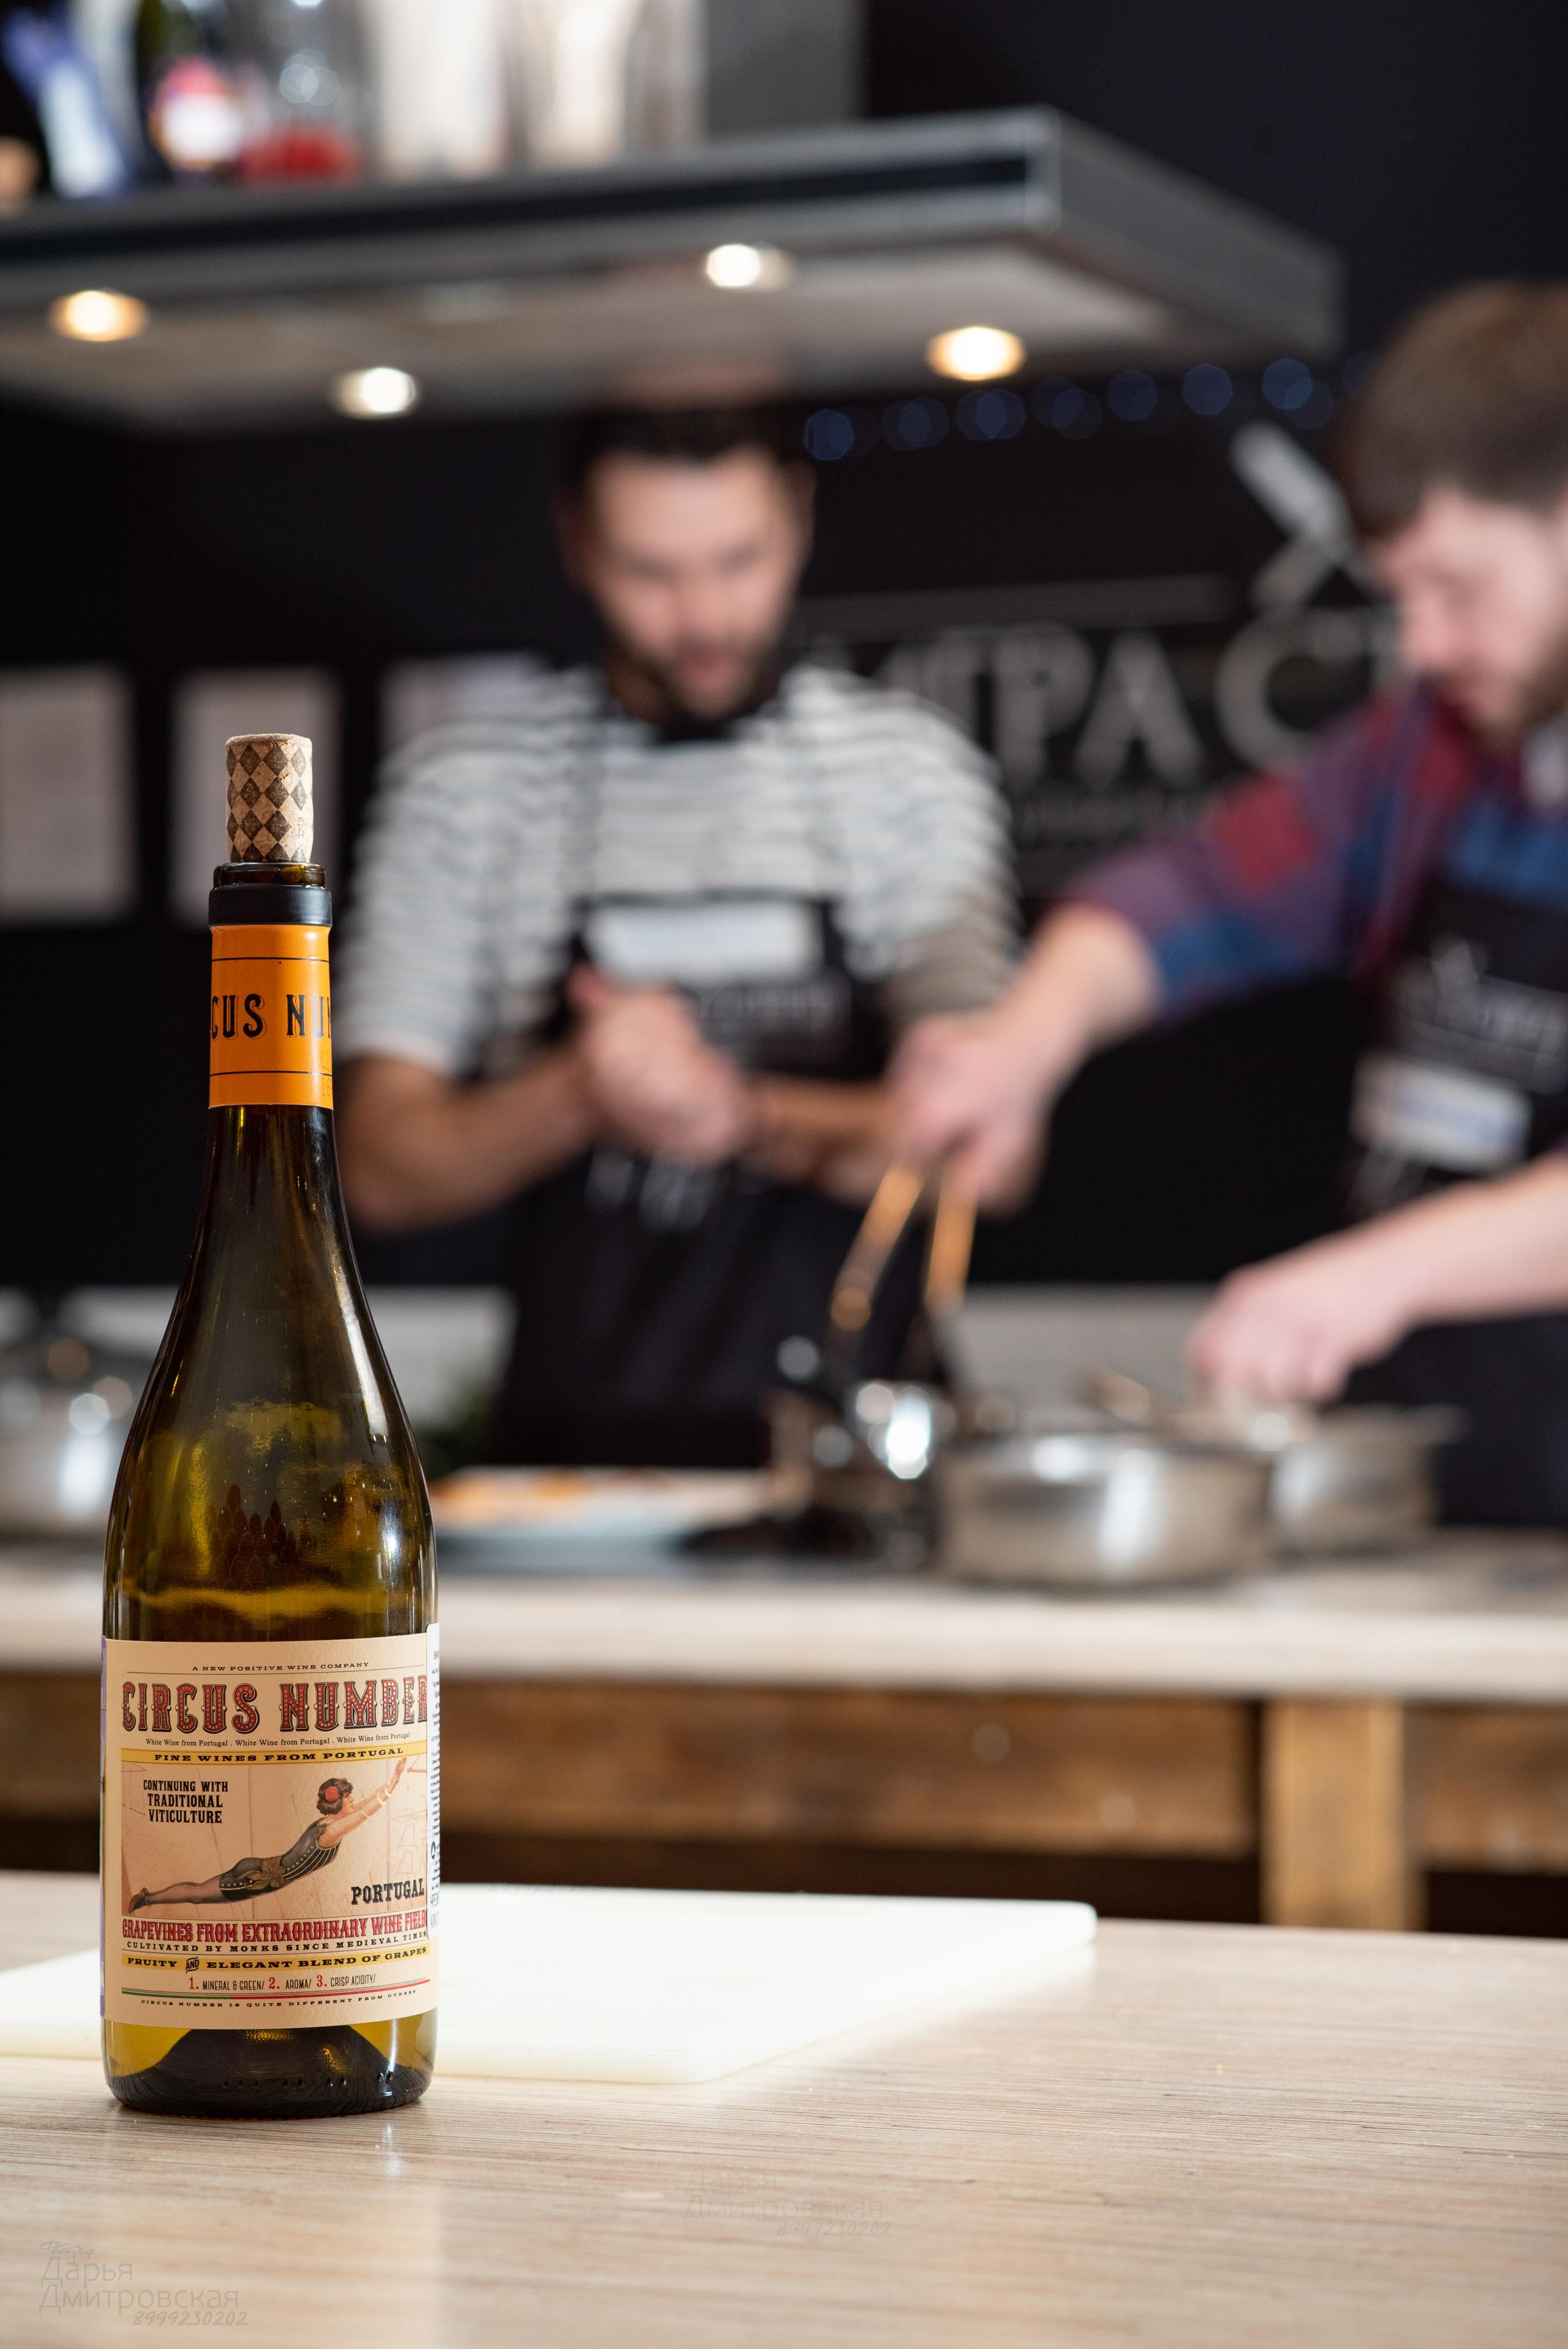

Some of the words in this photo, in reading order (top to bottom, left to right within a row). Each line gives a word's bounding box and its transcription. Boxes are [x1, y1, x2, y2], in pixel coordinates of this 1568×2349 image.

[286, 994, 331, 1038] NU
[122, 1681, 260, 1734] CIRCUS
[279, 1674, 427, 1731] NUMBER
[390, 1731, 410, 1740] Portugal
[323, 1748, 403, 1759] PORTUGAL
[143, 1780, 196, 1792] CONTINUING
[201, 1781, 228, 1792] WITH
[147, 1793, 223, 1808] TRADITIONAL
[148, 1809, 222, 1824] VITICULTURE
[351, 1878, 424, 1905] PORTUGAL
[122, 1918, 194, 1942] GRAPEVINES
[197, 1923, 238, 1943] FROM
[242, 1918, 368, 1943] EXTRAORDINARY
[371, 1913, 402, 1935] WINE
[405, 1908, 428, 1931] FIELD
[127, 1941, 198, 1951] CULTIVATED
[286, 1943, 329, 1951] SINCE
[336, 1936, 399, 1948] MEDIEVAL
[403, 1931, 426, 1941] TIMES
[127, 1957, 177, 1967] FRUITY
[185, 1958, 200, 1972] AND
[298, 1957, 356, 1967] BLEND
[385, 1946, 427, 1960] GRAPES
[189, 1976, 199, 1989] 1.
[202, 1980, 230, 1991] MINERAL
[233, 1980, 238, 1990] &
[239, 1981, 265, 1991] GREEN/
[269, 1976, 280, 1989] 2.
[285, 1979, 312, 1989] AROMA/
[317, 1974, 328, 1987] 3.
[330, 1976, 349, 1987] CRISP
[351, 1973, 376, 1985] ACIDITY/
